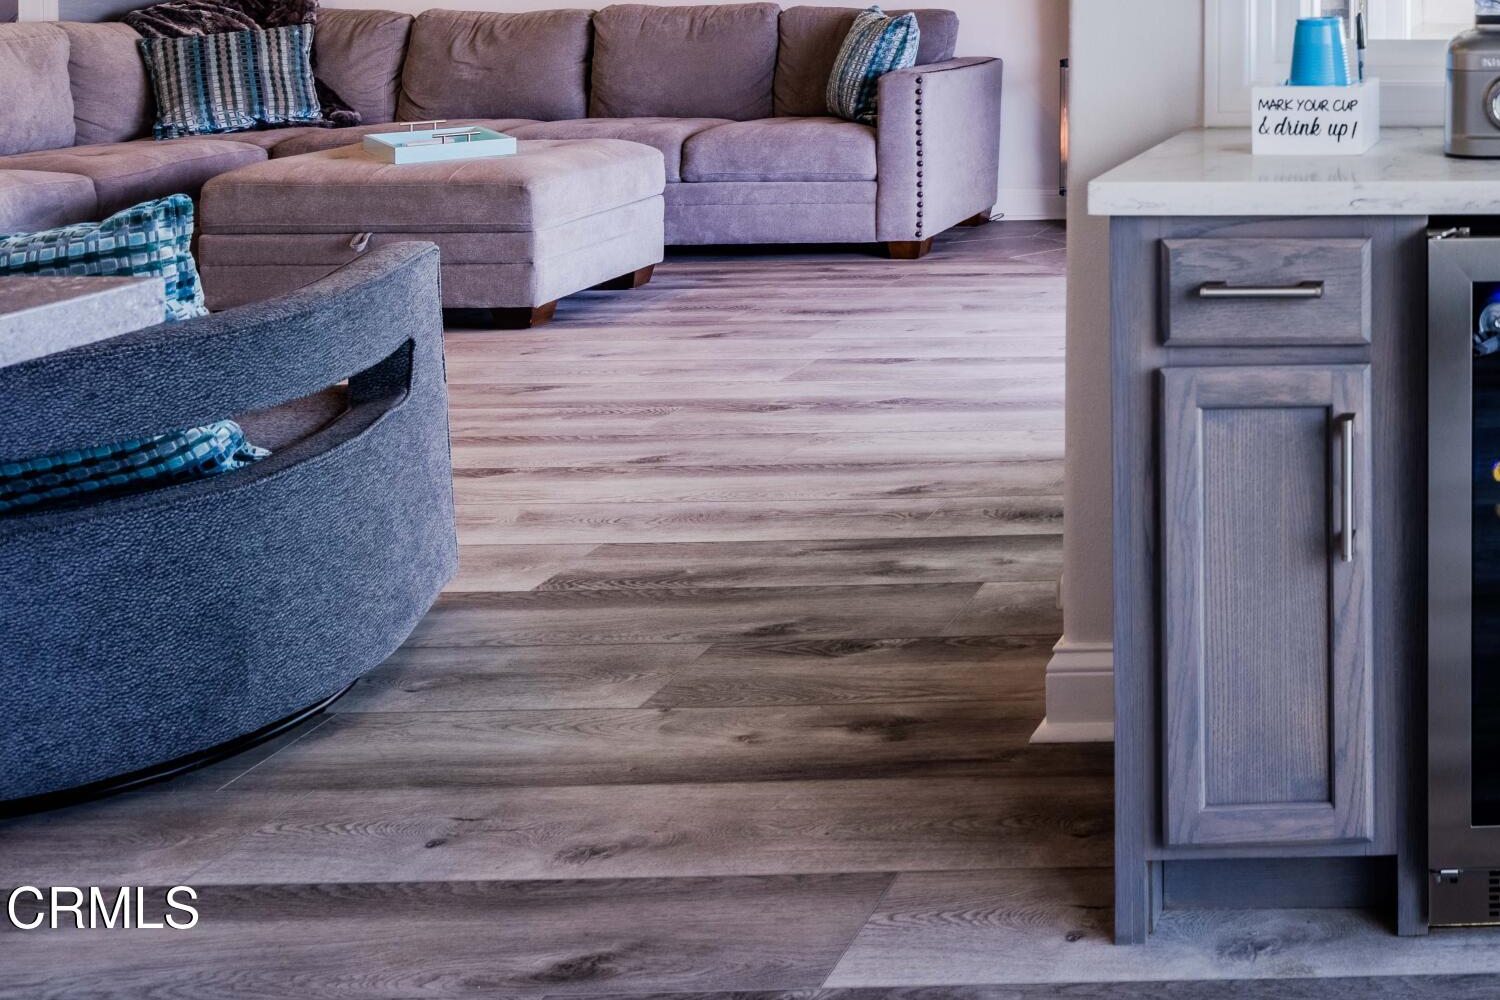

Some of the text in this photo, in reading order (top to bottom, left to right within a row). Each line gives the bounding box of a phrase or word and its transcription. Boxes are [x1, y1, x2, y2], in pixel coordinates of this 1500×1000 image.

[1258, 99, 1358, 112] MARK YOUR CUP
[1274, 116, 1321, 136] drink
